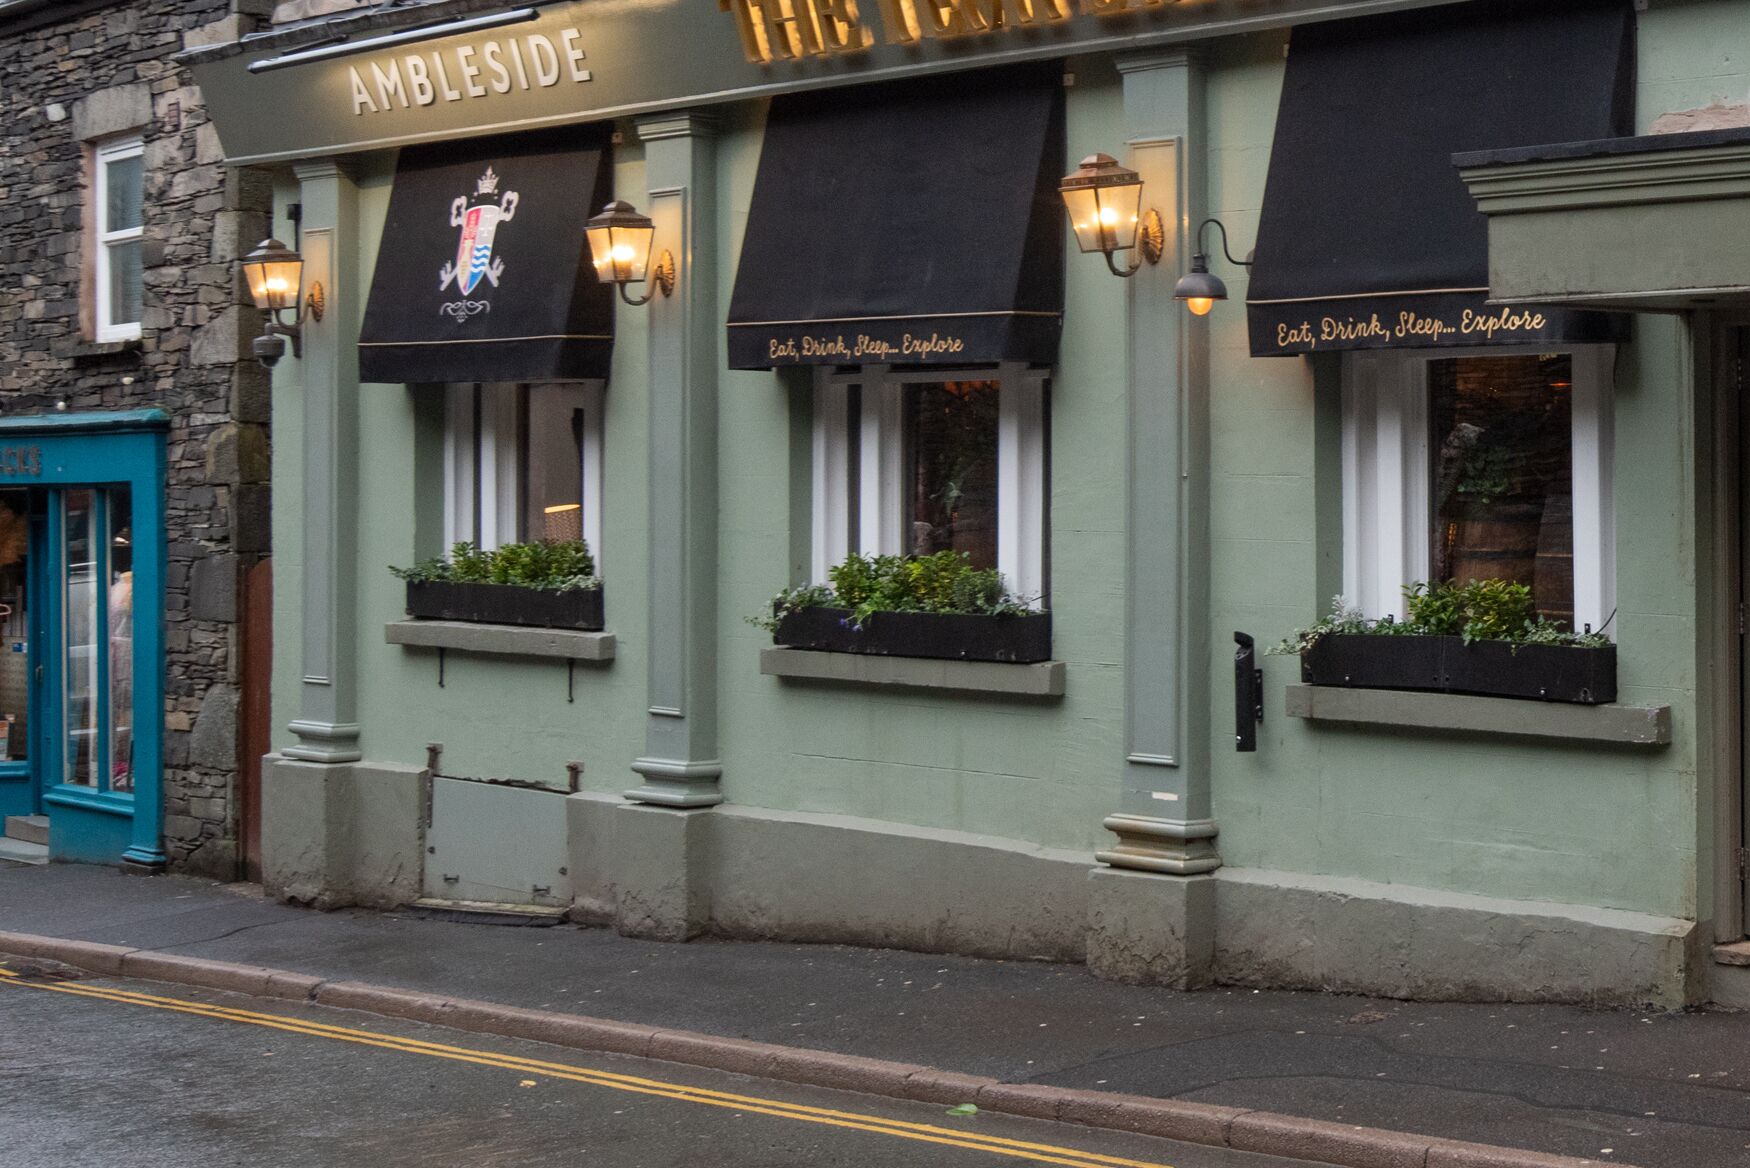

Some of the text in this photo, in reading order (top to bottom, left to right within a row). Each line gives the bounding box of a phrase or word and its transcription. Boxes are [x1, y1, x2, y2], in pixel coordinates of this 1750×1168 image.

[349, 28, 592, 115] AMBLESIDE
[769, 333, 964, 362] Eat, Drink, Sleep... Explore
[1277, 307, 1546, 348] Eat, Drink, Sleep... Explore
